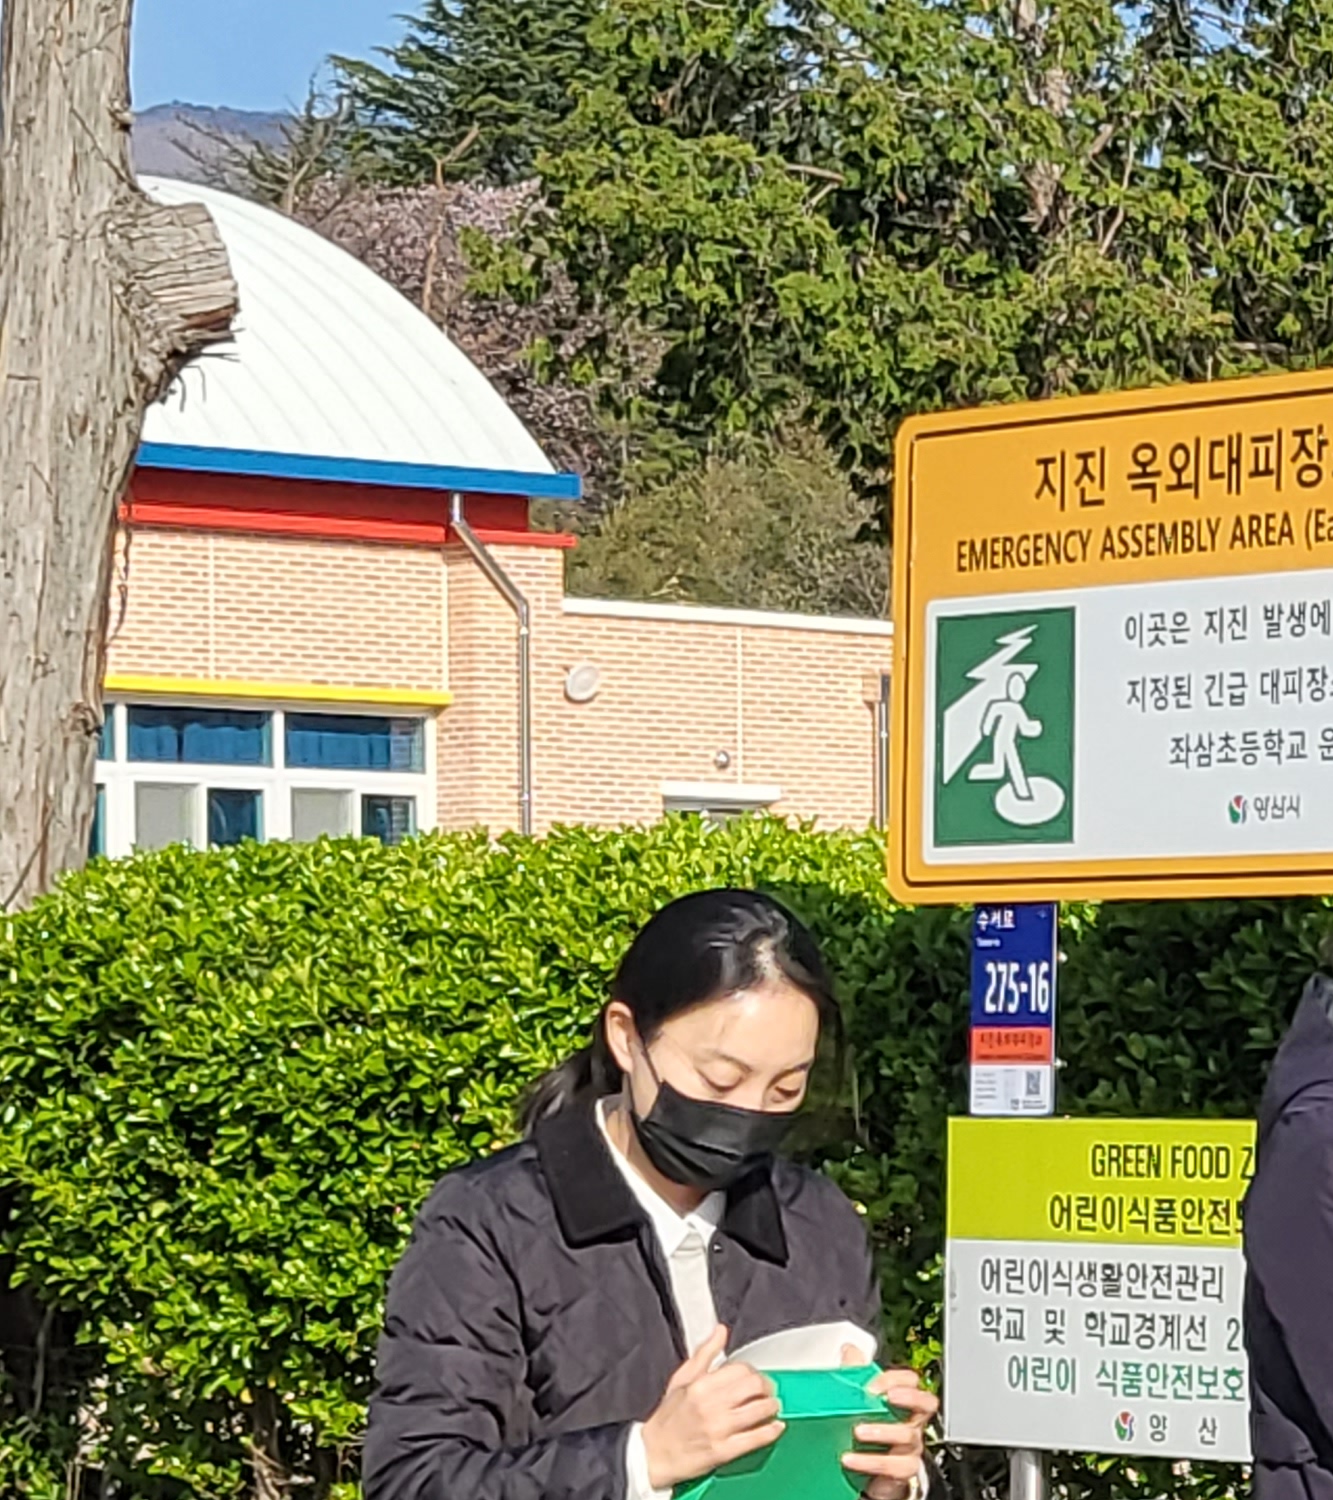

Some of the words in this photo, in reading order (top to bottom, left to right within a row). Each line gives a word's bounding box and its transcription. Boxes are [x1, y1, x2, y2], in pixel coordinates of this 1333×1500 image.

[1034, 446, 1105, 512] 지진
[957, 529, 1091, 573] EMERGENCY
[1100, 517, 1221, 561] ASSEMBLY
[1229, 512, 1294, 549] AREA
[1125, 611, 1190, 648] 이곳은
[1204, 605, 1248, 644] 지진
[1263, 599, 1331, 639] 발생에
[1127, 673, 1192, 712] 지정된
[1204, 672, 1248, 707] 긴급
[1169, 728, 1308, 769] 좌삼초등학교
[1253, 794, 1301, 821] 양산시
[984, 961, 1049, 1014] 275-16
[1091, 1144, 1161, 1179] GREEN
[1170, 1144, 1230, 1180] FOOD
[980, 1259, 1224, 1303] 어린이식생활안전관리
[980, 1307, 1025, 1341] 학교
[1044, 1308, 1066, 1345] 및
[1085, 1311, 1207, 1351] 학교경계선
[1008, 1356, 1076, 1394] 어린이
[1096, 1360, 1245, 1401] 식품안전보호
